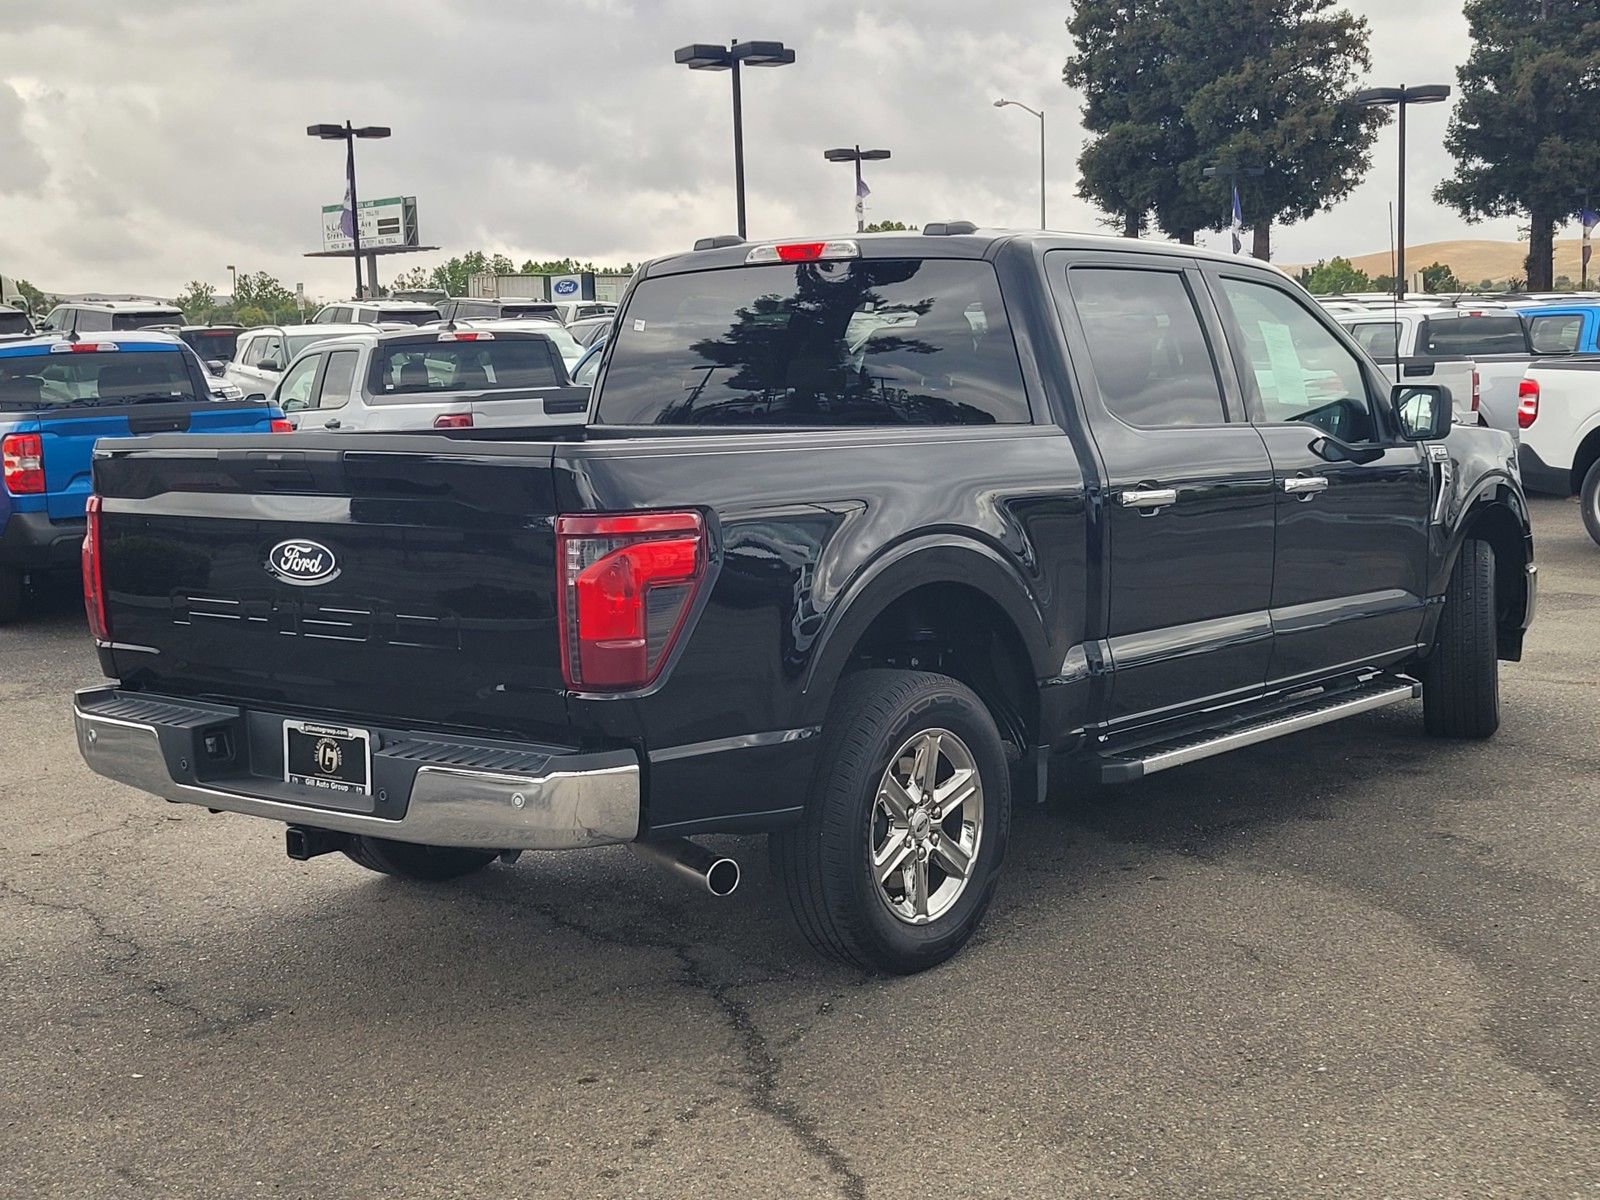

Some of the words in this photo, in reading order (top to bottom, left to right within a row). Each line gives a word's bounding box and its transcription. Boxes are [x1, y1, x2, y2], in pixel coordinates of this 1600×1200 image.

[558, 281, 574, 293] Ford
[280, 544, 323, 573] Ford
[305, 778, 315, 787] Gill
[316, 780, 330, 789] Auto
[330, 782, 349, 792] Group
